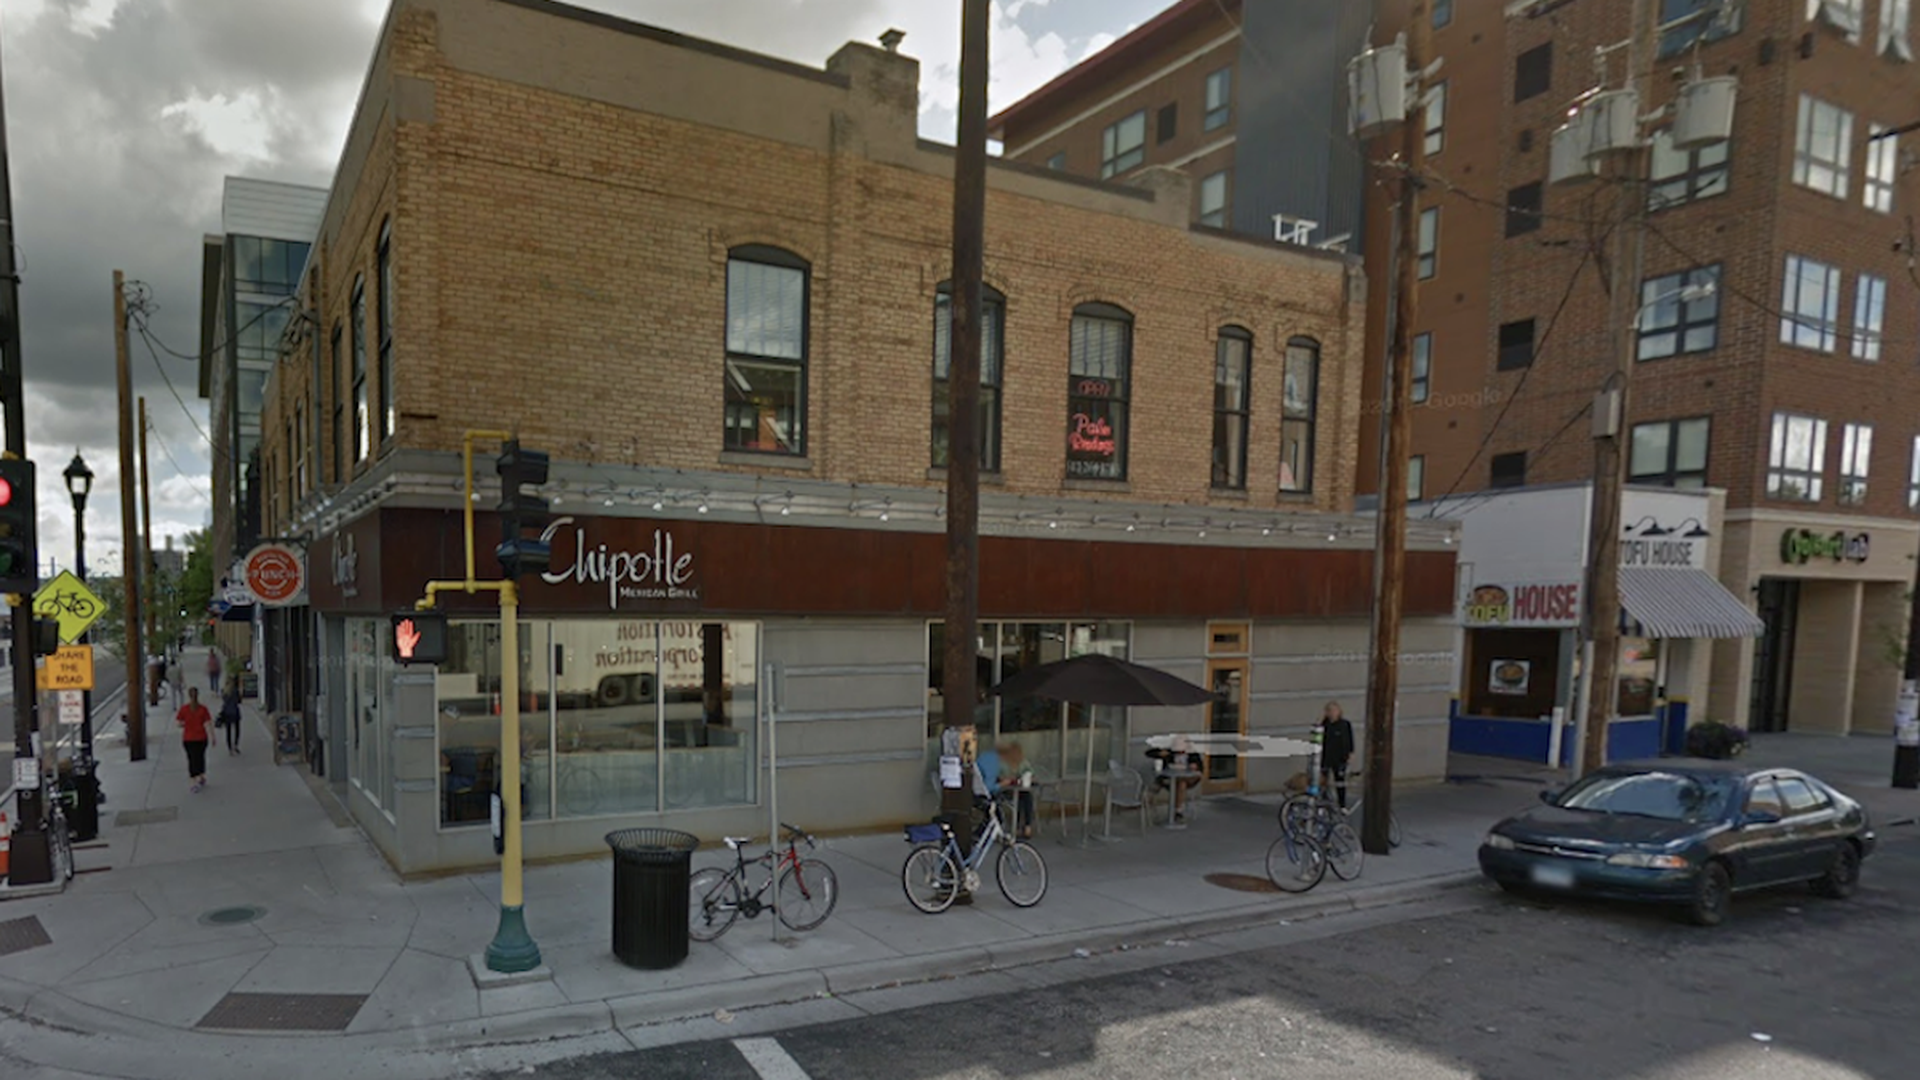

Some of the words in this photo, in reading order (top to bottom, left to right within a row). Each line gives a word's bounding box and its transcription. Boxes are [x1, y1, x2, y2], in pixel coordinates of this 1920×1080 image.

[540, 516, 694, 609] Chipotle
[1652, 542, 1692, 566] HOUSE
[1512, 583, 1578, 621] HOUSE
